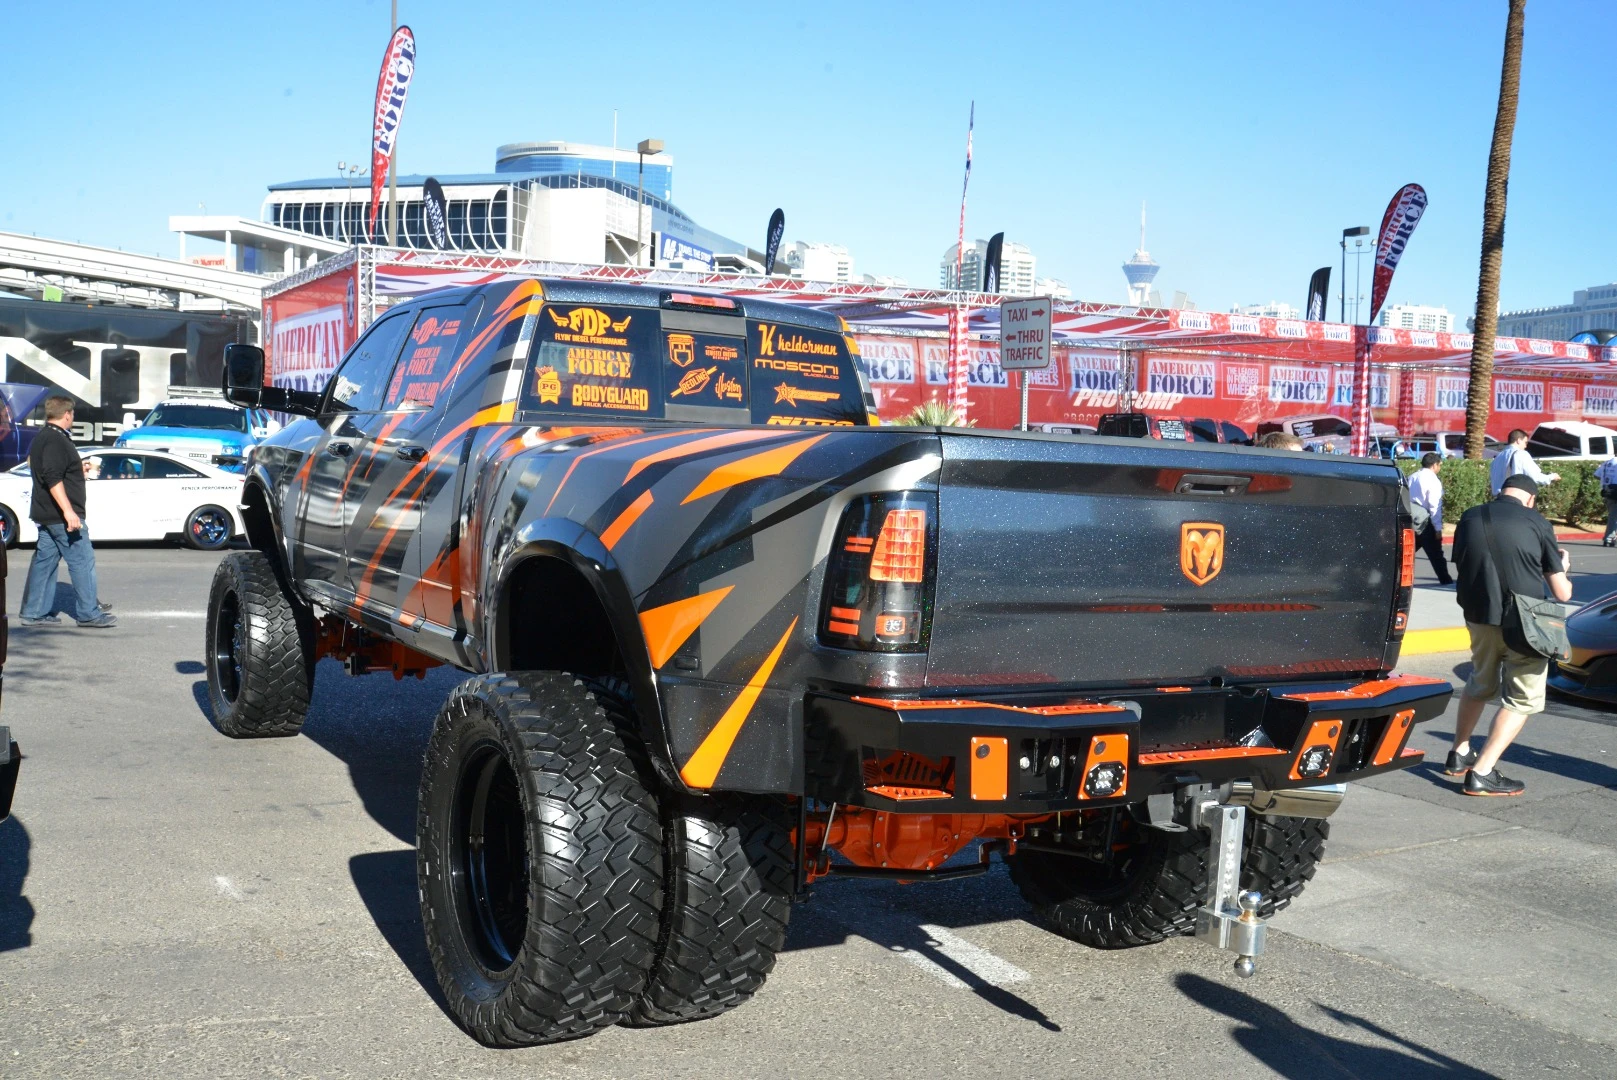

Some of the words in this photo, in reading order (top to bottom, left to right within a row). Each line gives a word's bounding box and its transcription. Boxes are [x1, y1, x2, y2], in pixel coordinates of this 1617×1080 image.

[379, 37, 416, 154] FORCE
[1377, 187, 1413, 264] AMERICAN
[1384, 191, 1428, 269] FORCE
[568, 307, 611, 336] FDP
[1008, 308, 1028, 322] TAXI
[1017, 329, 1044, 343] THRU
[274, 319, 342, 375] AMERICAN
[567, 348, 631, 362] AMERICAN
[1005, 346, 1043, 361] TRAFFIC
[567, 357, 631, 379] FORCE
[1149, 361, 1213, 376] AMERICAN
[1271, 368, 1327, 382] AMERICAN
[682, 371, 708, 393] REDLINE
[1149, 374, 1213, 396] FORCE
[1270, 380, 1327, 401] FORCE
[1496, 382, 1543, 394] AMERICAN
[572, 384, 649, 411] BODYGUARD
[1496, 392, 1543, 411] FORCE
